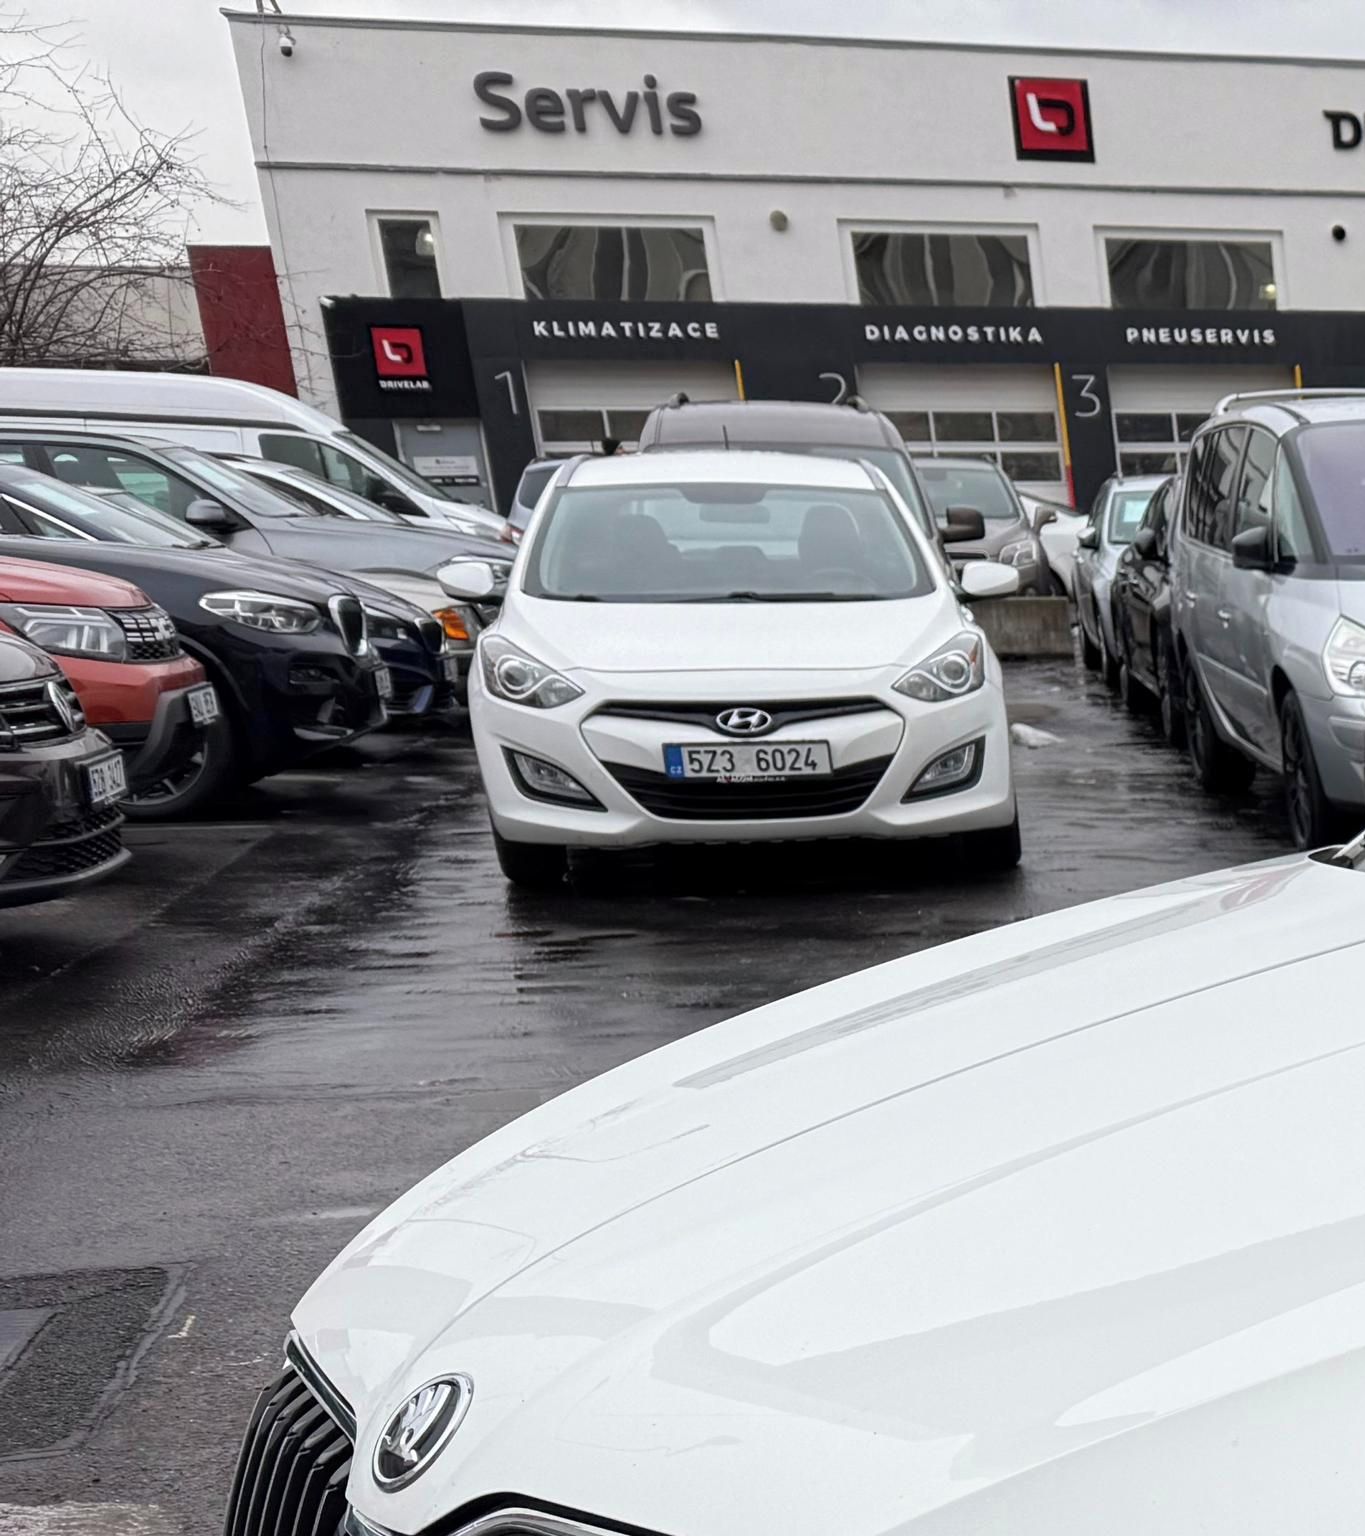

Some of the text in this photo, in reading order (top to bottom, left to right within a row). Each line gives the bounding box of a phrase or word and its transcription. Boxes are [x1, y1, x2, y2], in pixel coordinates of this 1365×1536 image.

[473, 71, 702, 136] Servis
[532, 320, 720, 340] KLIMATIZACE
[865, 324, 1044, 343] DIAGNOSTIKA
[1126, 327, 1276, 346] PNEUSERVIS
[378, 379, 431, 390] DRIVELAB
[495, 370, 520, 415] 1
[1071, 374, 1101, 417] 3
[687, 747, 818, 774] 5Z3 6024
